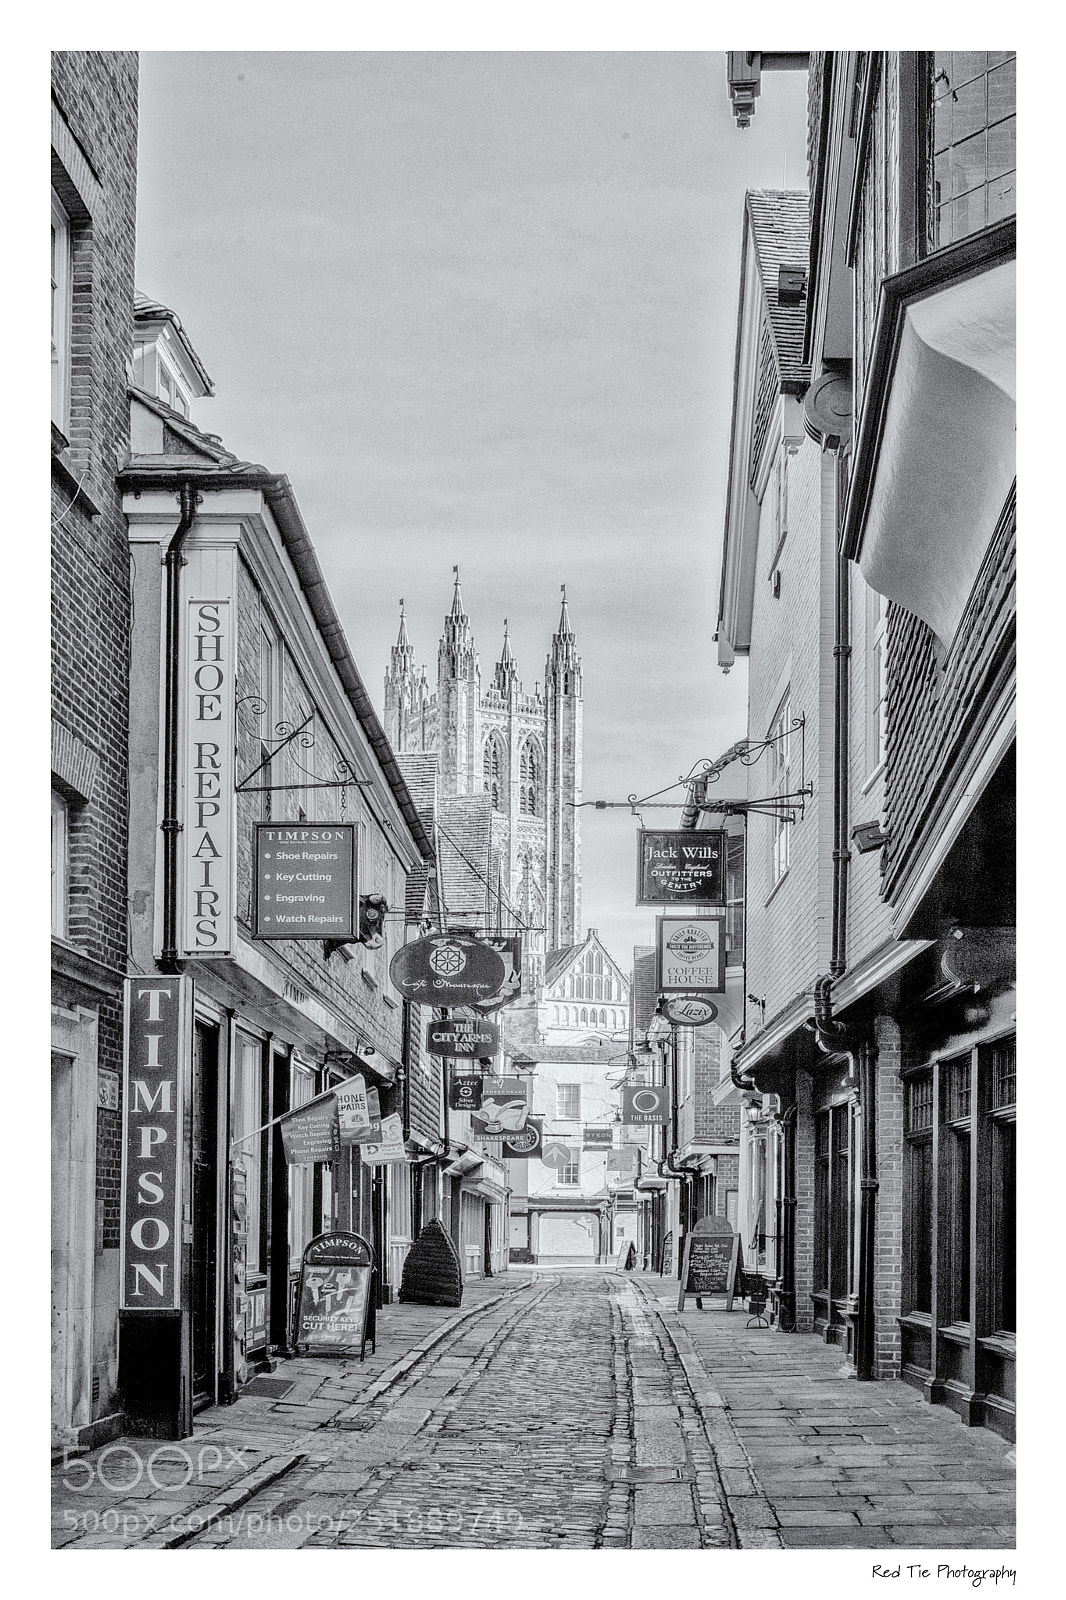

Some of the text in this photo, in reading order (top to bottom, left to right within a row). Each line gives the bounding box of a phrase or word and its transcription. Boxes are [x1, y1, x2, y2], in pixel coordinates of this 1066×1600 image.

[192, 605, 225, 947] SHOE REPAIRS
[266, 831, 344, 841] TIMPSON
[276, 852, 338, 862] Shoe Repairs
[645, 846, 719, 862] Jack Wills
[276, 873, 332, 883] Key Cutting
[661, 879, 702, 889] GENTRY
[276, 894, 325, 904] Engraving
[276, 915, 344, 925] Watch Repairs
[687, 929, 708, 941] ROASTED
[667, 967, 713, 975] COFFEE
[668, 975, 713, 984] HOUSE
[454, 1023, 474, 1033] THE
[432, 1032, 492, 1043] CITY ARMS
[454, 1043, 474, 1052] INN
[337, 1093, 365, 1104] HONE
[337, 1102, 366, 1111] EPAIRS
[630, 1114, 663, 1122] THE OASIS
[130, 989, 175, 1297] TIMPSON
[312, 1238, 365, 1255] TIMPSON
[302, 1321, 359, 1332] CUT HERE!
